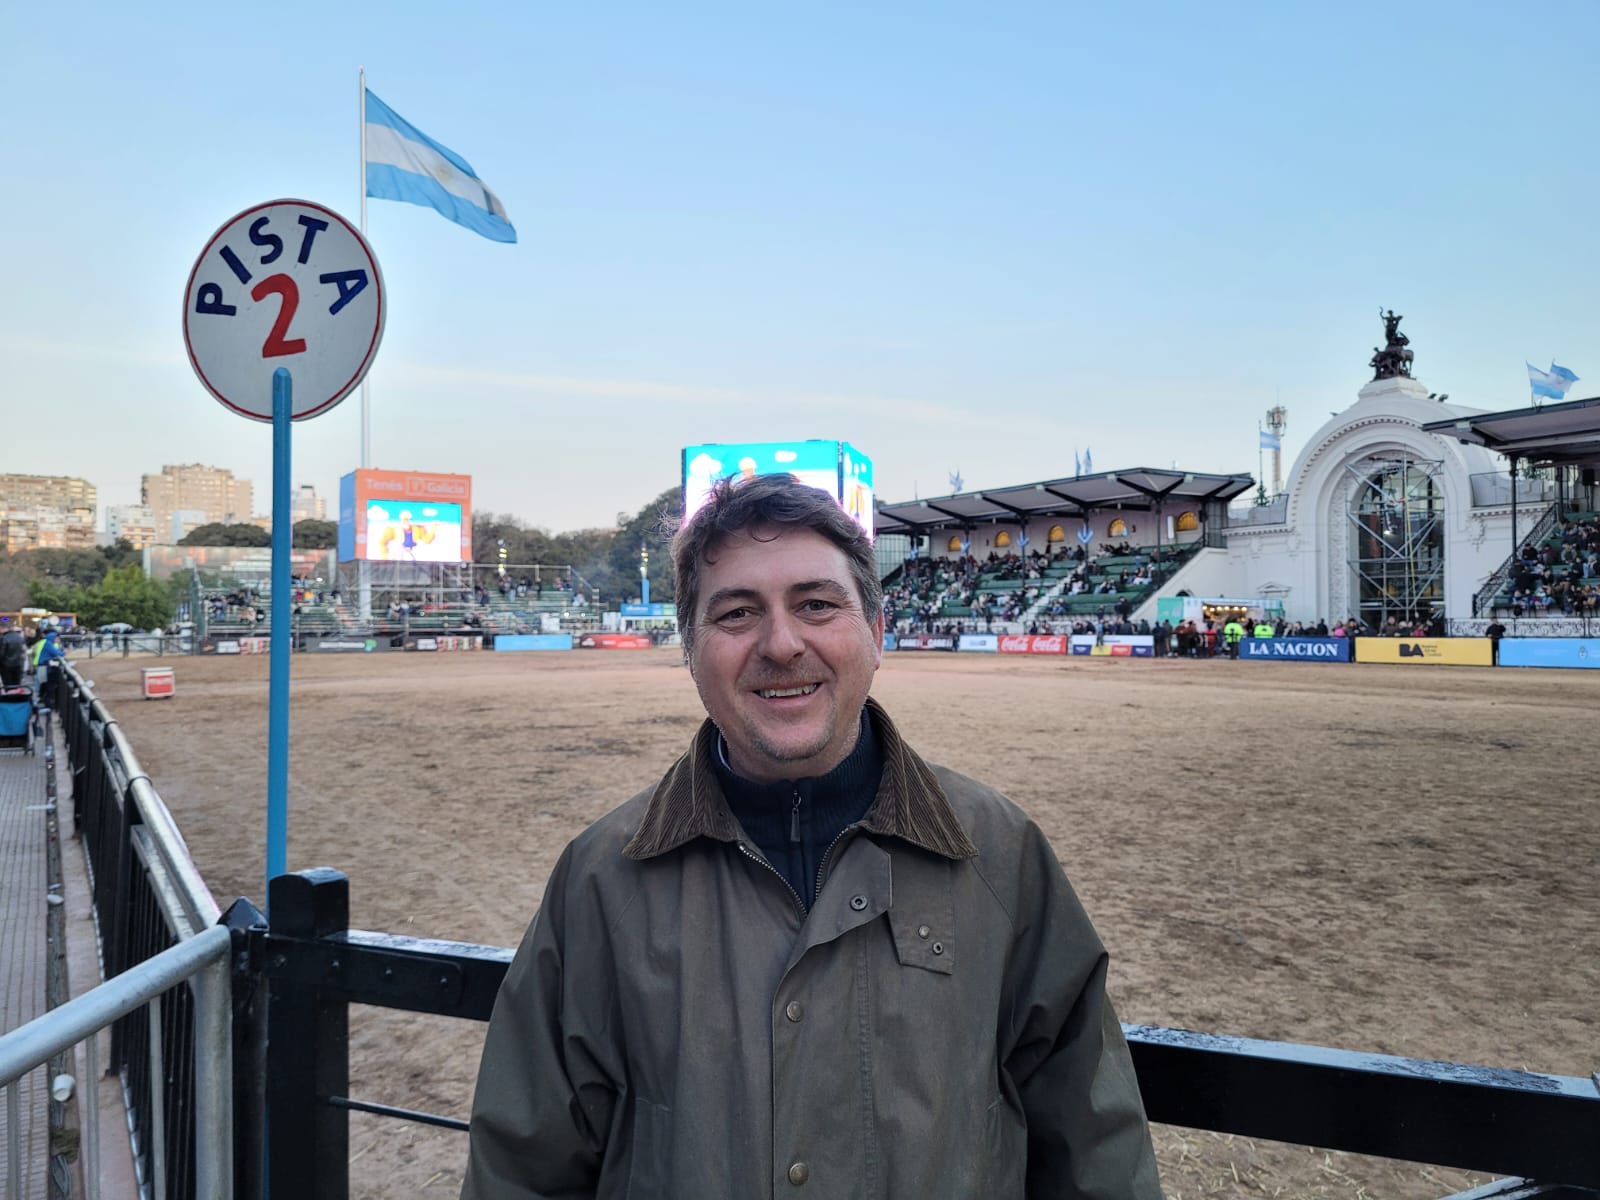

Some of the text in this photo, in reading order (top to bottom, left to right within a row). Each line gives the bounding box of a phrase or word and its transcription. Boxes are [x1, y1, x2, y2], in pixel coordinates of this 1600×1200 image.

[195, 214, 369, 317] PISTA
[251, 273, 307, 359] 2
[426, 482, 465, 494] Galicia
[1249, 642, 1338, 657] LA NACION
[1399, 643, 1424, 657] BA
